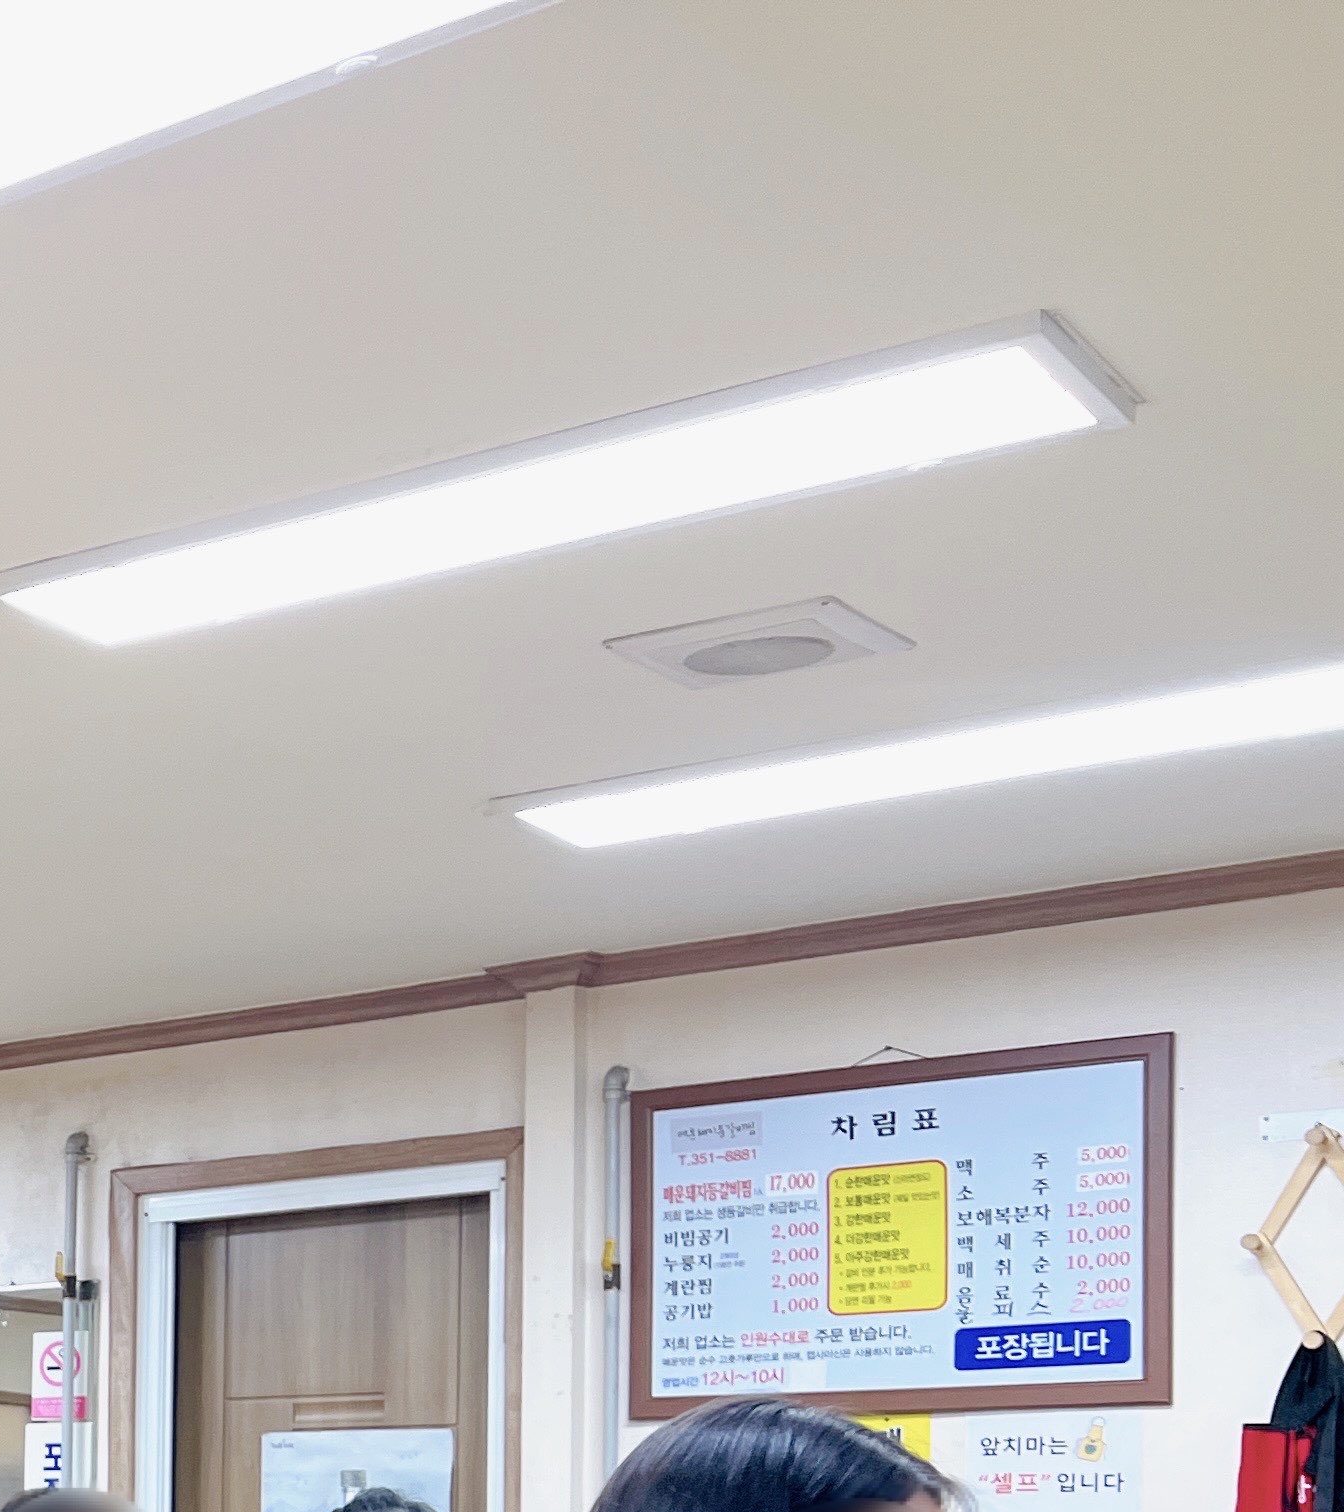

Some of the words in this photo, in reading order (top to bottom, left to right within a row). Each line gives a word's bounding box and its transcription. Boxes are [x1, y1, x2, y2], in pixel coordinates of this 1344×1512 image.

[678, 1149, 757, 1166] T.351-8881
[770, 1173, 815, 1192] 17,000
[664, 1227, 729, 1247] 비빔공기
[663, 1253, 712, 1272] 누룽지
[664, 1278, 712, 1296] 계란찜
[664, 1303, 713, 1321] 공기밥
[663, 1336, 689, 1350] 저희
[694, 1335, 736, 1350] 업소는
[814, 1328, 843, 1343] 주문
[975, 1328, 1110, 1361] 포장됩니다
[980, 1435, 1069, 1457] 앞치마는
